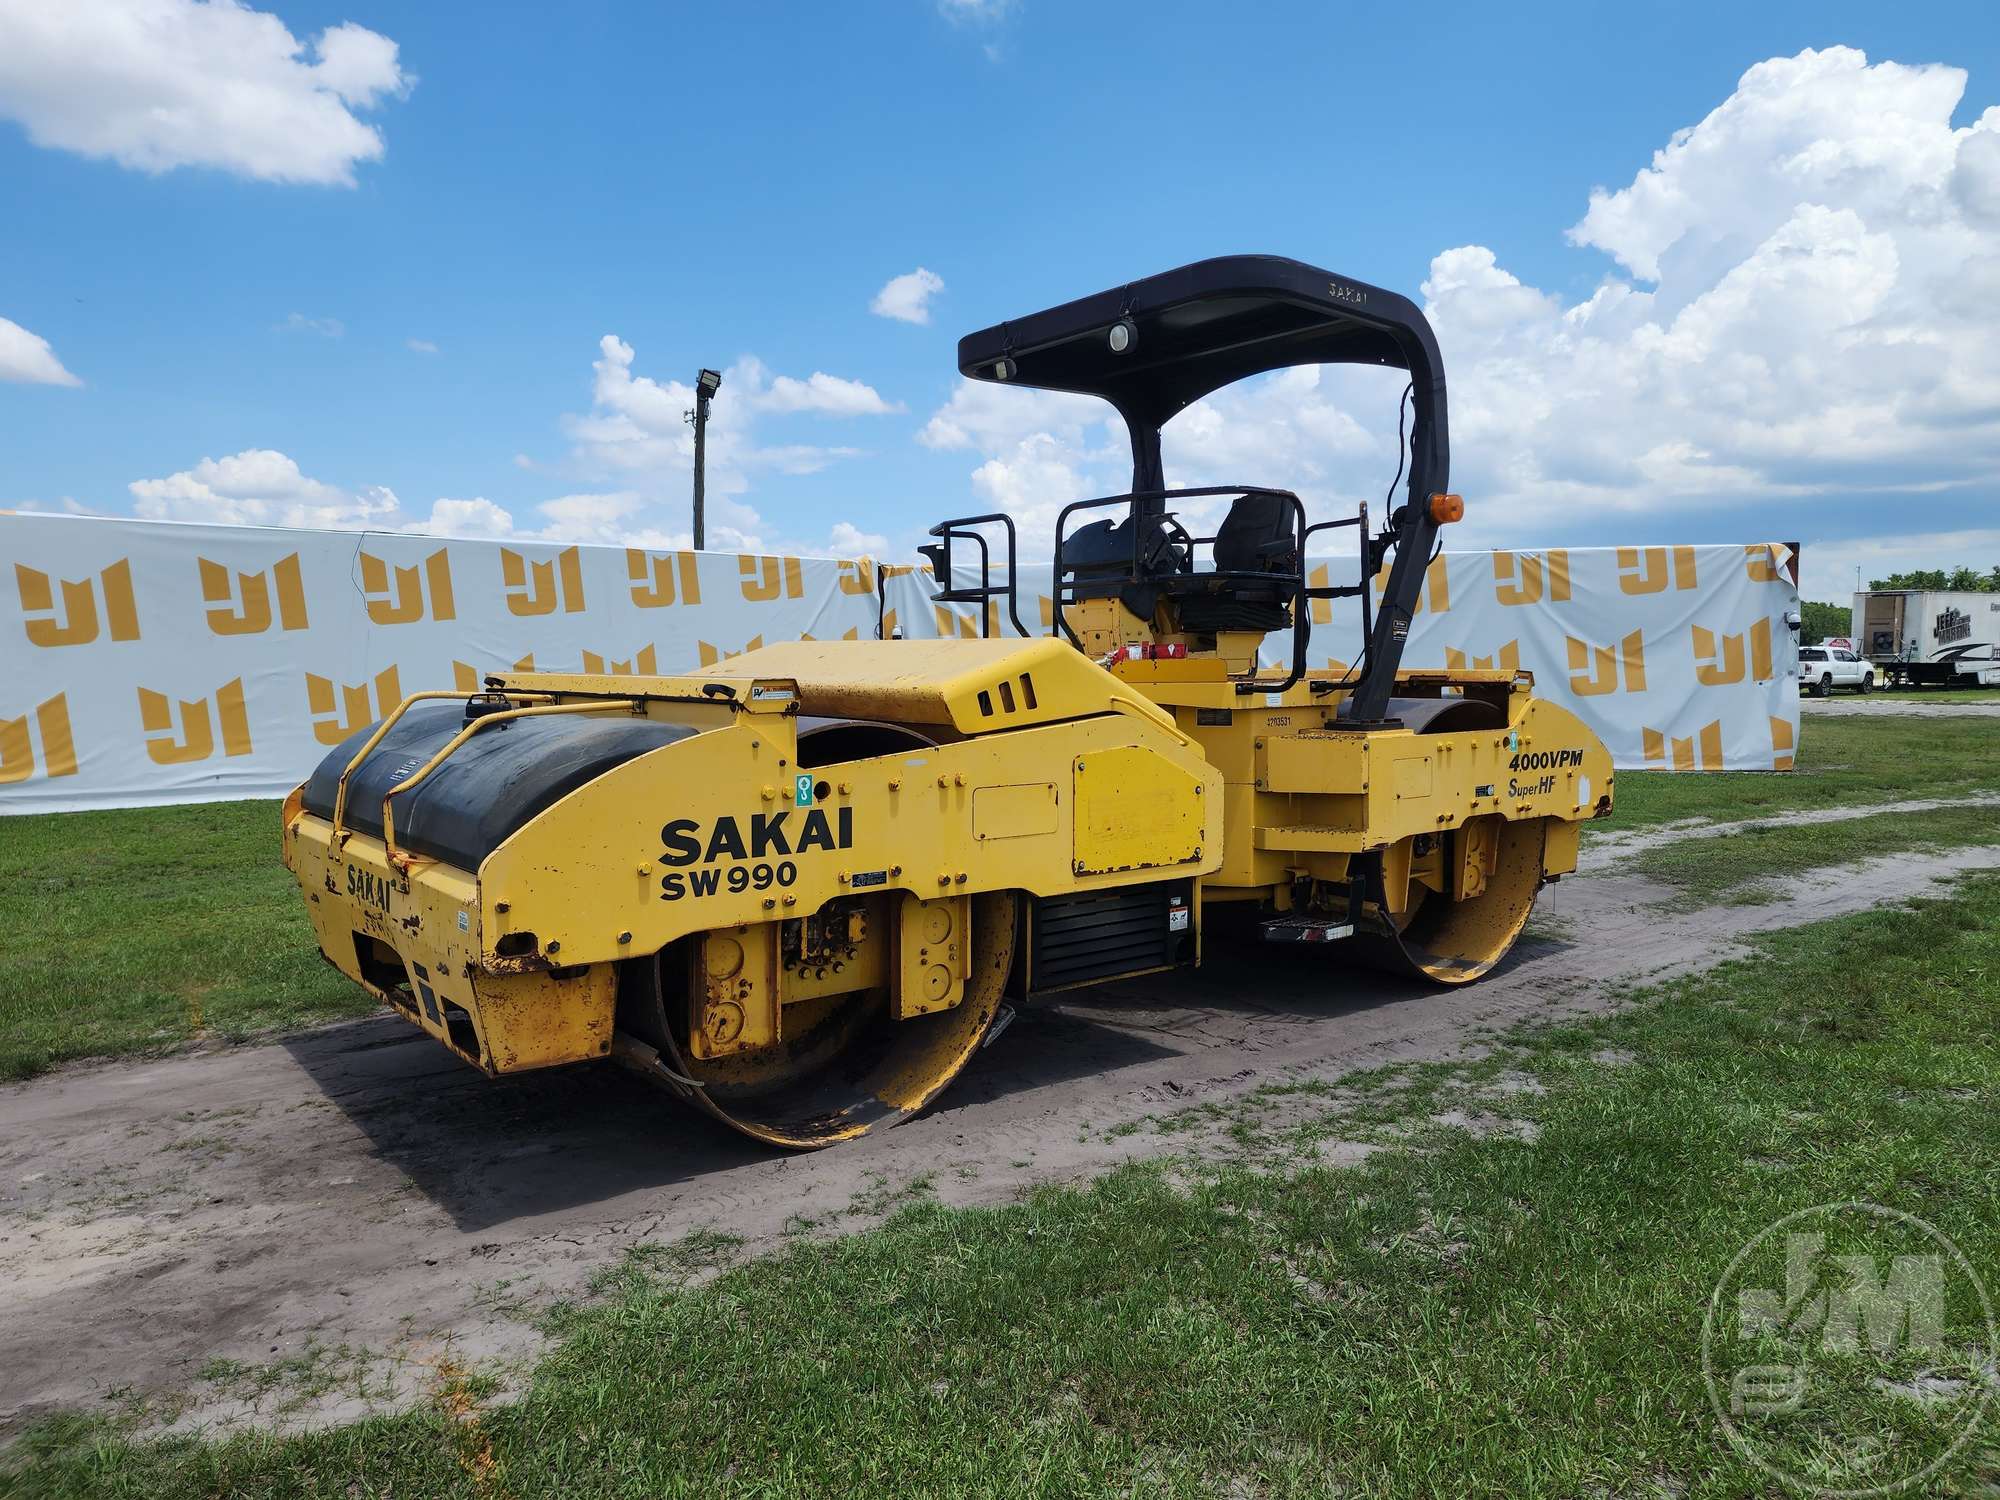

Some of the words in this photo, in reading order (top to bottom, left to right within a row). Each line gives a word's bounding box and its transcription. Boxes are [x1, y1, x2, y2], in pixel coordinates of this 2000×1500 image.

[658, 806, 852, 867] SAKAI
[347, 864, 391, 913] SAKAI
[660, 861, 797, 901] SW990
